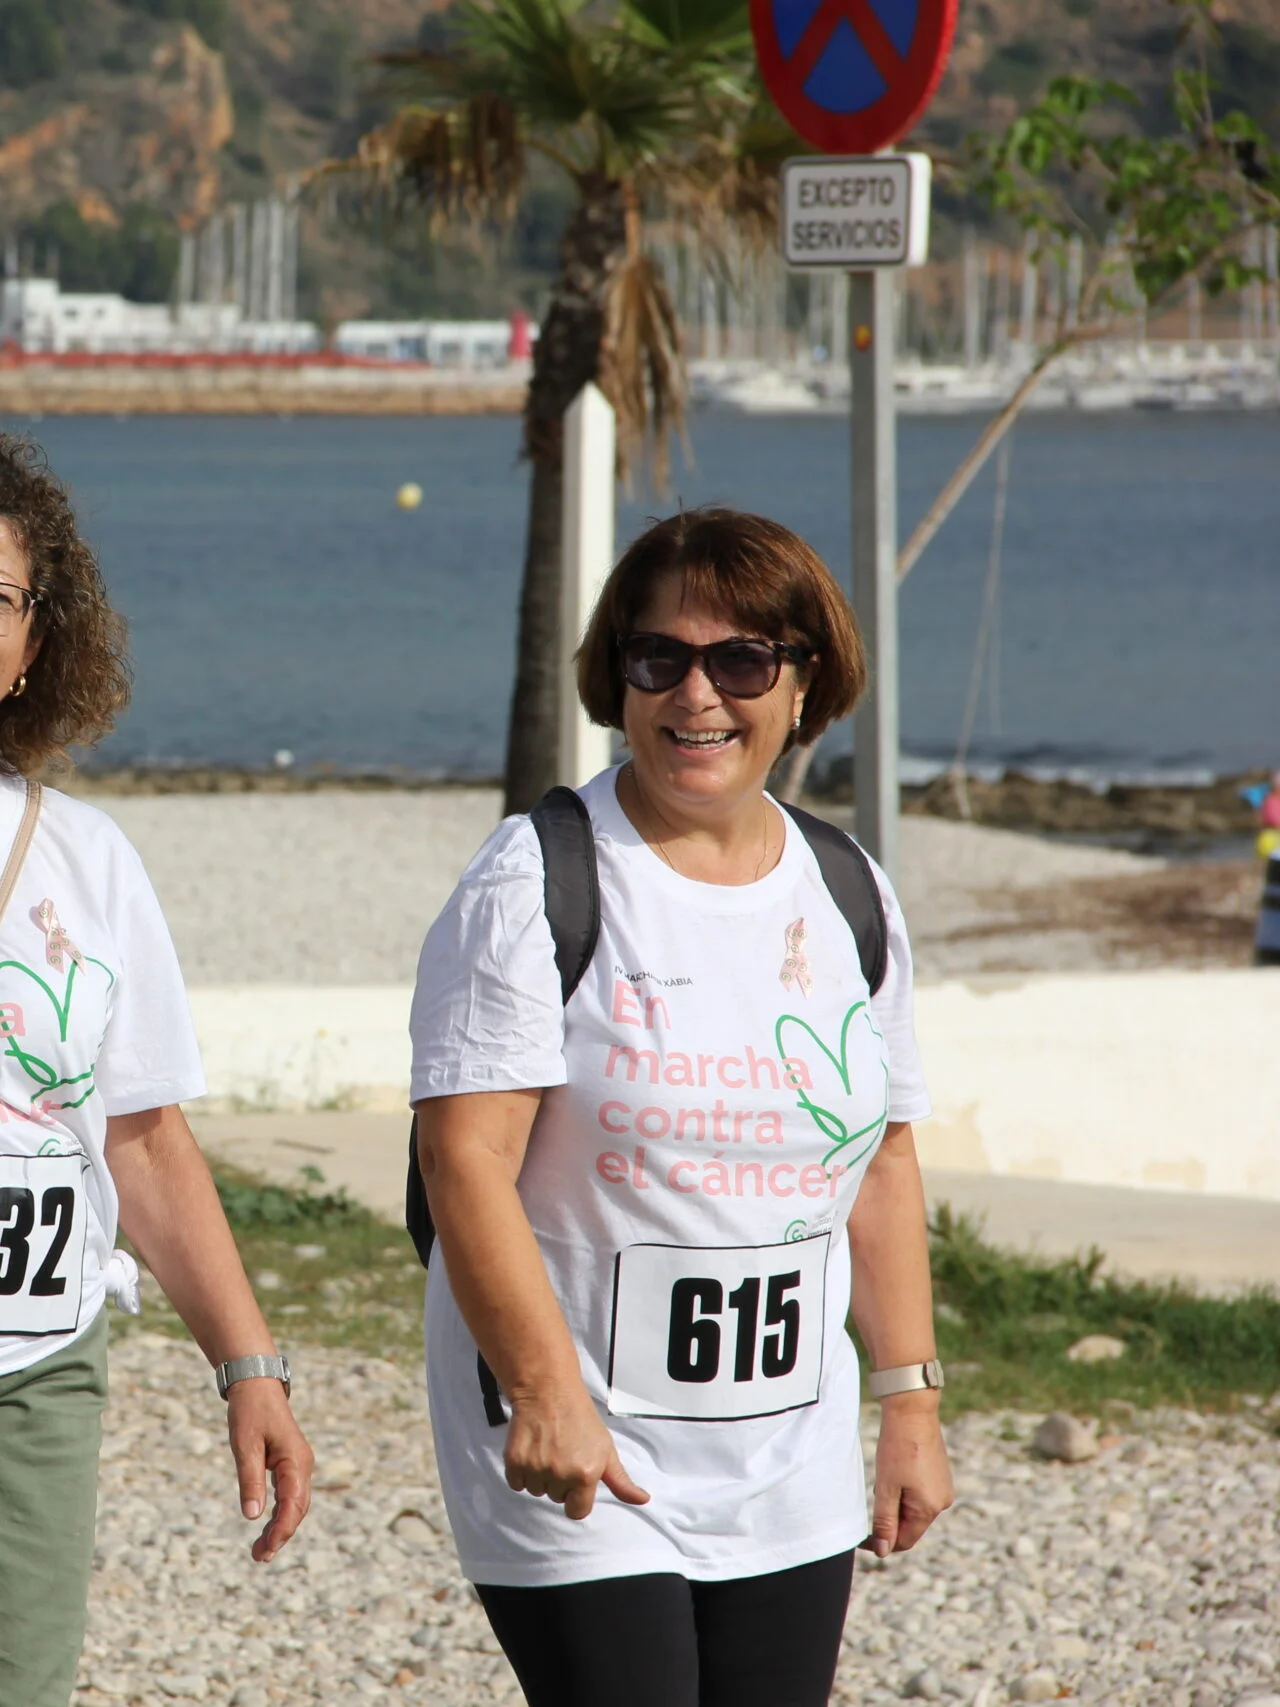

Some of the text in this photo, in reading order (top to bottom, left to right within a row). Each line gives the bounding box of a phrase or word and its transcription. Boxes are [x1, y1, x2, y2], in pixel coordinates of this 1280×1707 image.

[799, 177, 894, 208] EXCEPTO
[792, 219, 901, 250] SERVICIOS
[611, 979, 671, 1030] En
[604, 1045, 813, 1090] marcha
[597, 1100, 784, 1144] contra
[595, 1146, 848, 1198] el cáncer
[666, 1270, 801, 1384] 615
